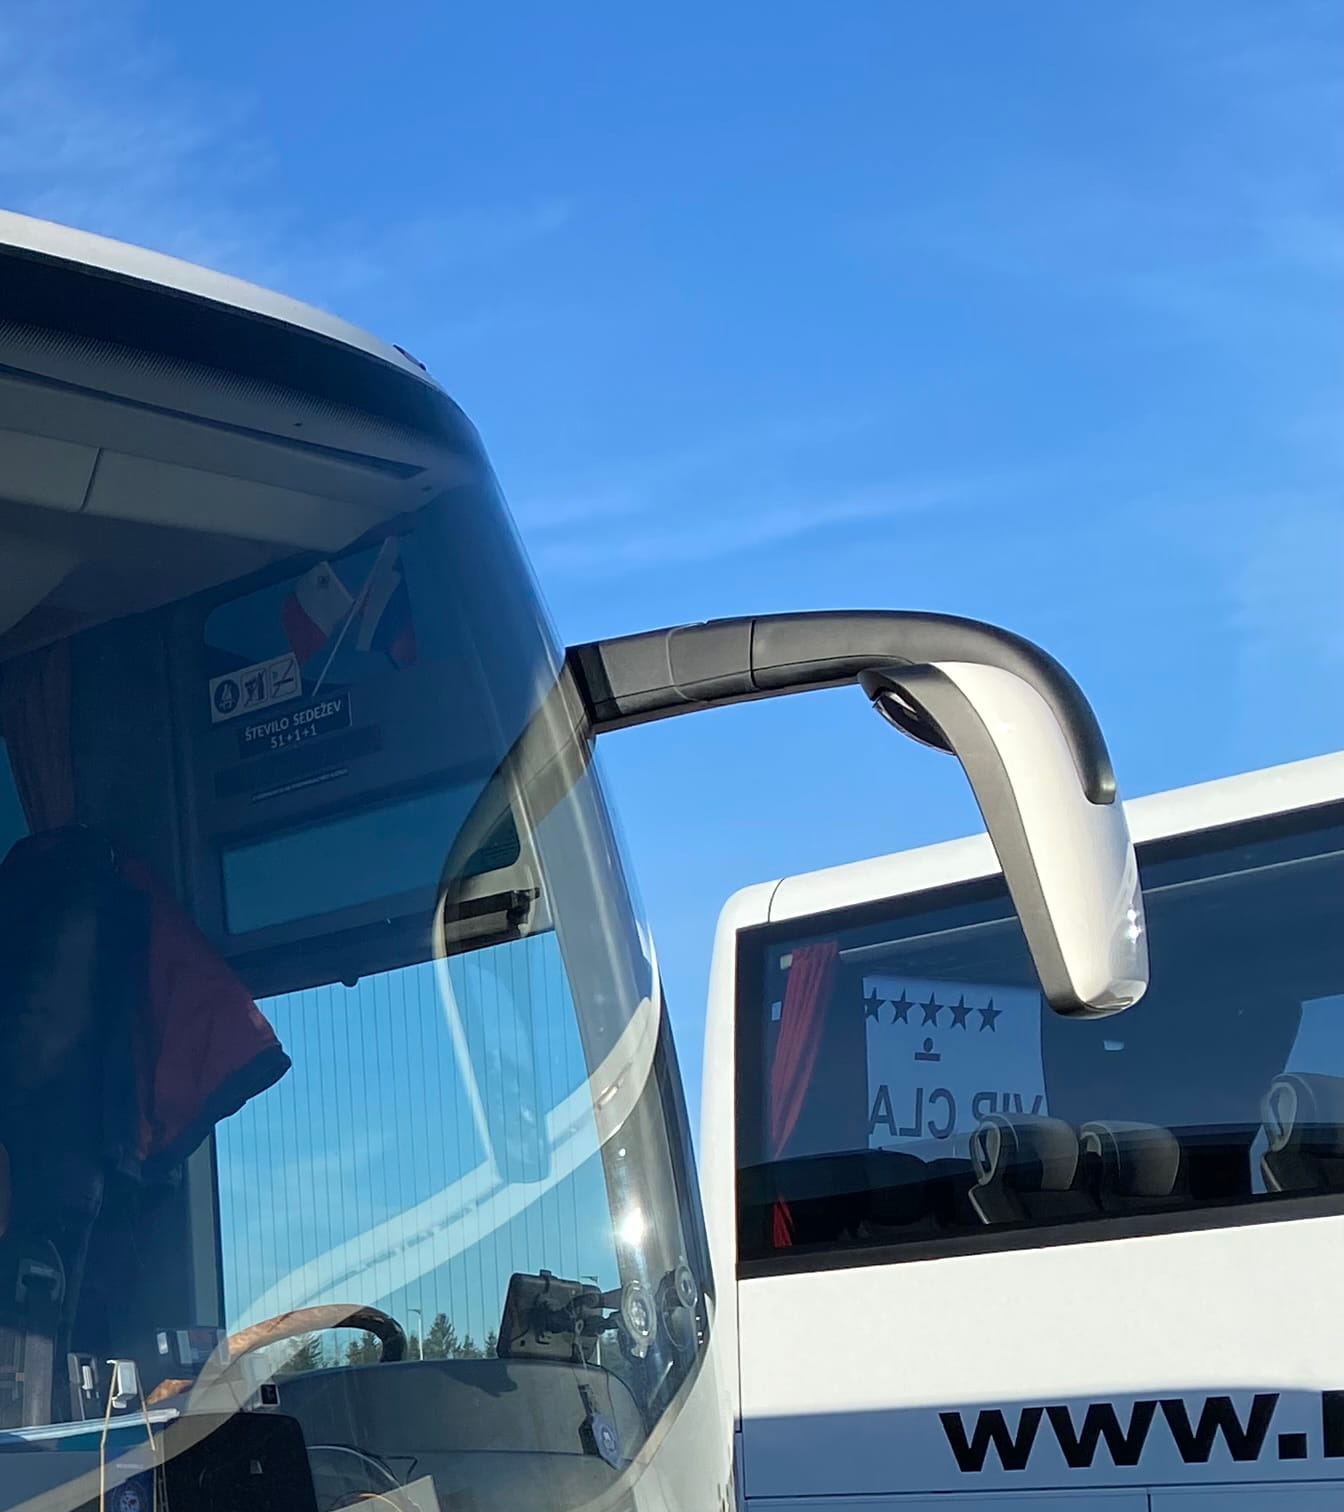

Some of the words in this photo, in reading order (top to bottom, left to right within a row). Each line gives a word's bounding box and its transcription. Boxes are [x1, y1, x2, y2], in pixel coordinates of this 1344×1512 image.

[244, 717, 289, 741] ŠTEVILO
[292, 699, 342, 726] SEDEŽEV
[938, 1391, 1344, 1472] www.
